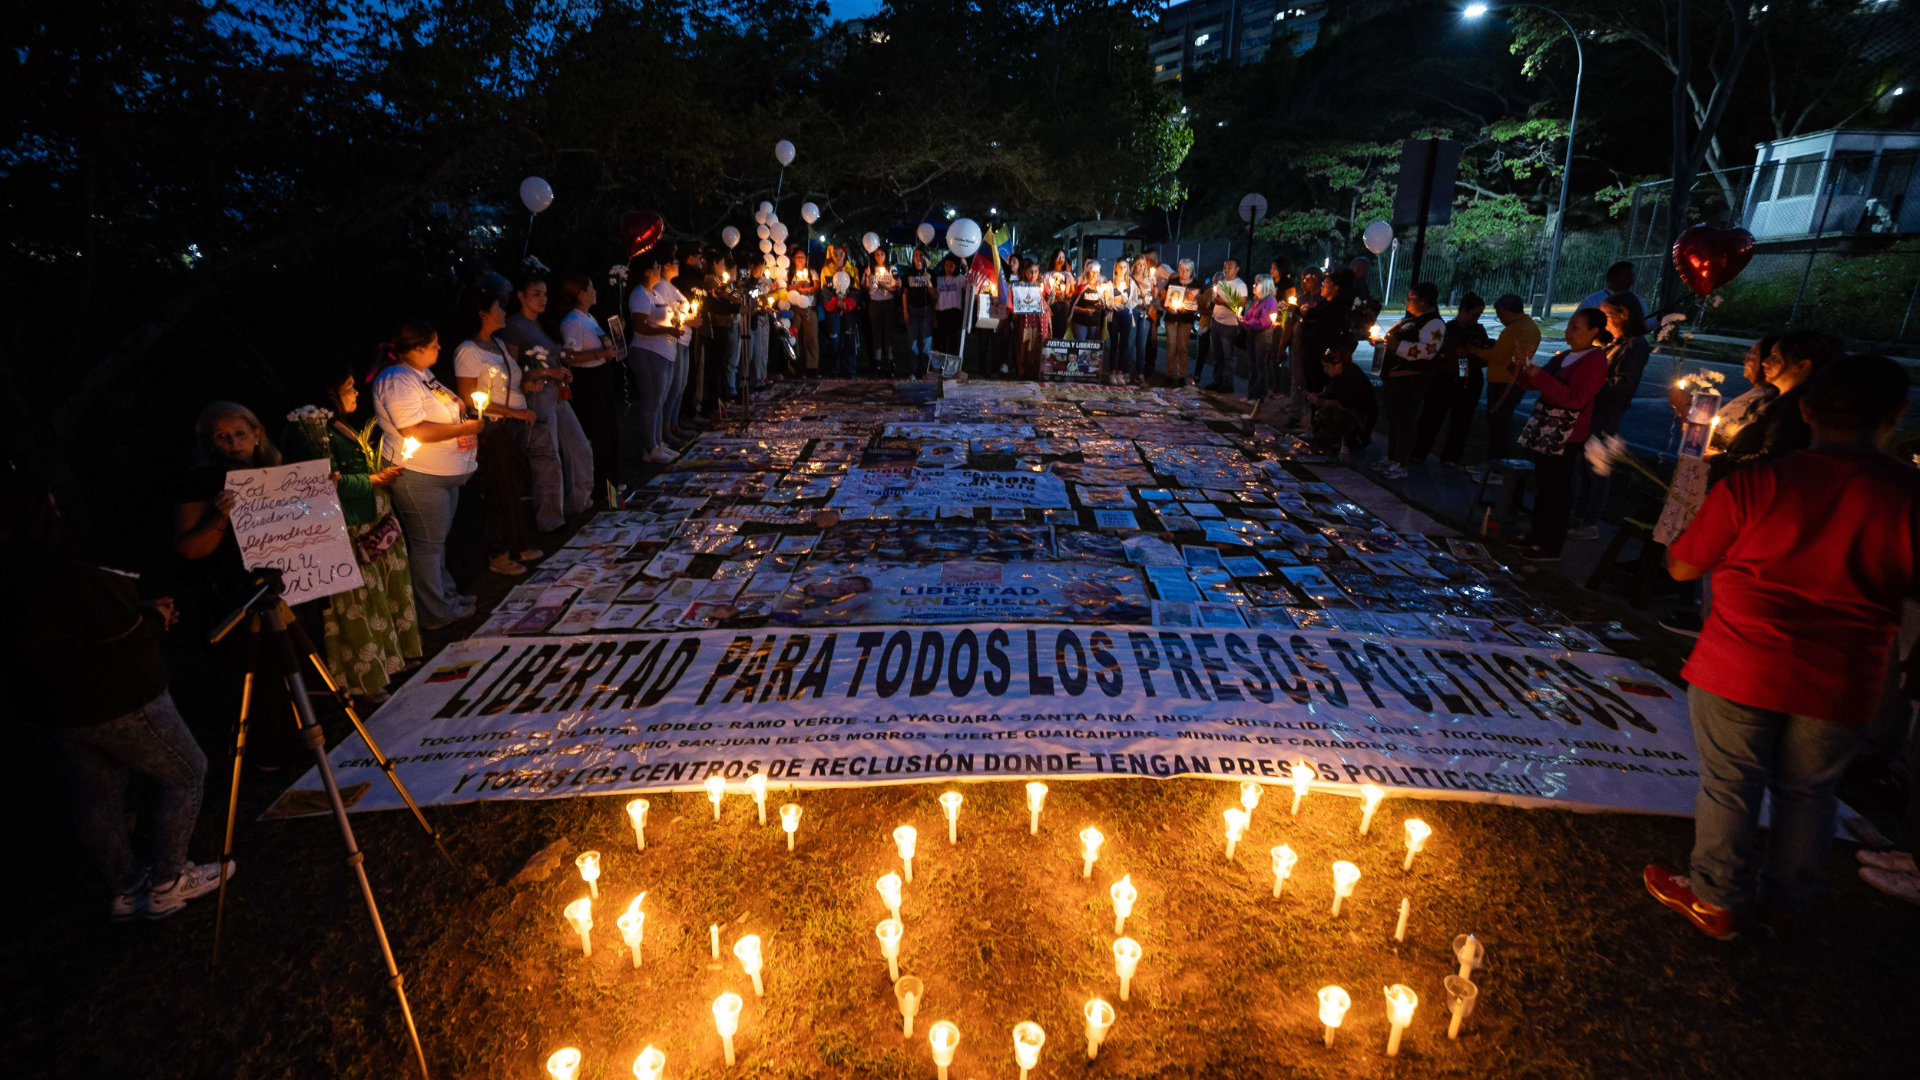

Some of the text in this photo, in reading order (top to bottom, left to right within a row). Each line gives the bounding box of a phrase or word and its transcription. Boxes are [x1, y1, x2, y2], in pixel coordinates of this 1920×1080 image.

[1046, 340, 1071, 348] JUSTICIA
[1076, 342, 1101, 350] LIBERTAD
[228, 477, 266, 500] Los
[886, 597, 1051, 606] VENEZUELA
[900, 586, 1040, 595] LIBERTAD
[431, 628, 1658, 734] LIBERTAD PARA TODOS LOS PRESOS POLITICOS
[419, 730, 513, 747] TOCUYITO
[557, 726, 630, 740] PLANTA
[646, 722, 713, 733] RODEO
[729, 719, 786, 730] RAMO
[793, 716, 857, 727] VERDE
[875, 713, 899, 723] LA
[907, 713, 1002, 724] YAGUARA
[1020, 713, 1088, 722] SANTA
[1095, 713, 1137, 723] ANA
[1366, 725, 1422, 738] YARE
[1437, 729, 1544, 747] TOCORON
[1558, 737, 1624, 755] FENIX
[1628, 746, 1689, 762] LARA
[611, 740, 671, 752] JUIO,
[678, 738, 717, 748] SAN
[720, 736, 770, 747] JUAN
[776, 735, 799, 745] DE
[804, 733, 841, 743] LOS
[846, 731, 926, 741] MORROS
[944, 730, 1018, 740] FUERTE
[1024, 729, 1160, 740] GUAICAIPURO
[1177, 730, 1252, 743] MINIMA
[1256, 736, 1284, 745] DE
[1288, 737, 1399, 751] CARABOBO
[1415, 745, 1518, 761] COMANDO
[452, 771, 478, 794] Y
[476, 769, 572, 793] TODOS
[570, 765, 630, 785] LOS
[629, 759, 761, 783] CENTROS
[766, 758, 805, 777] DE
[809, 749, 974, 777] RECLUSIÓN
[984, 753, 1082, 773] DONDE
[1089, 752, 1213, 775] TENGAN
